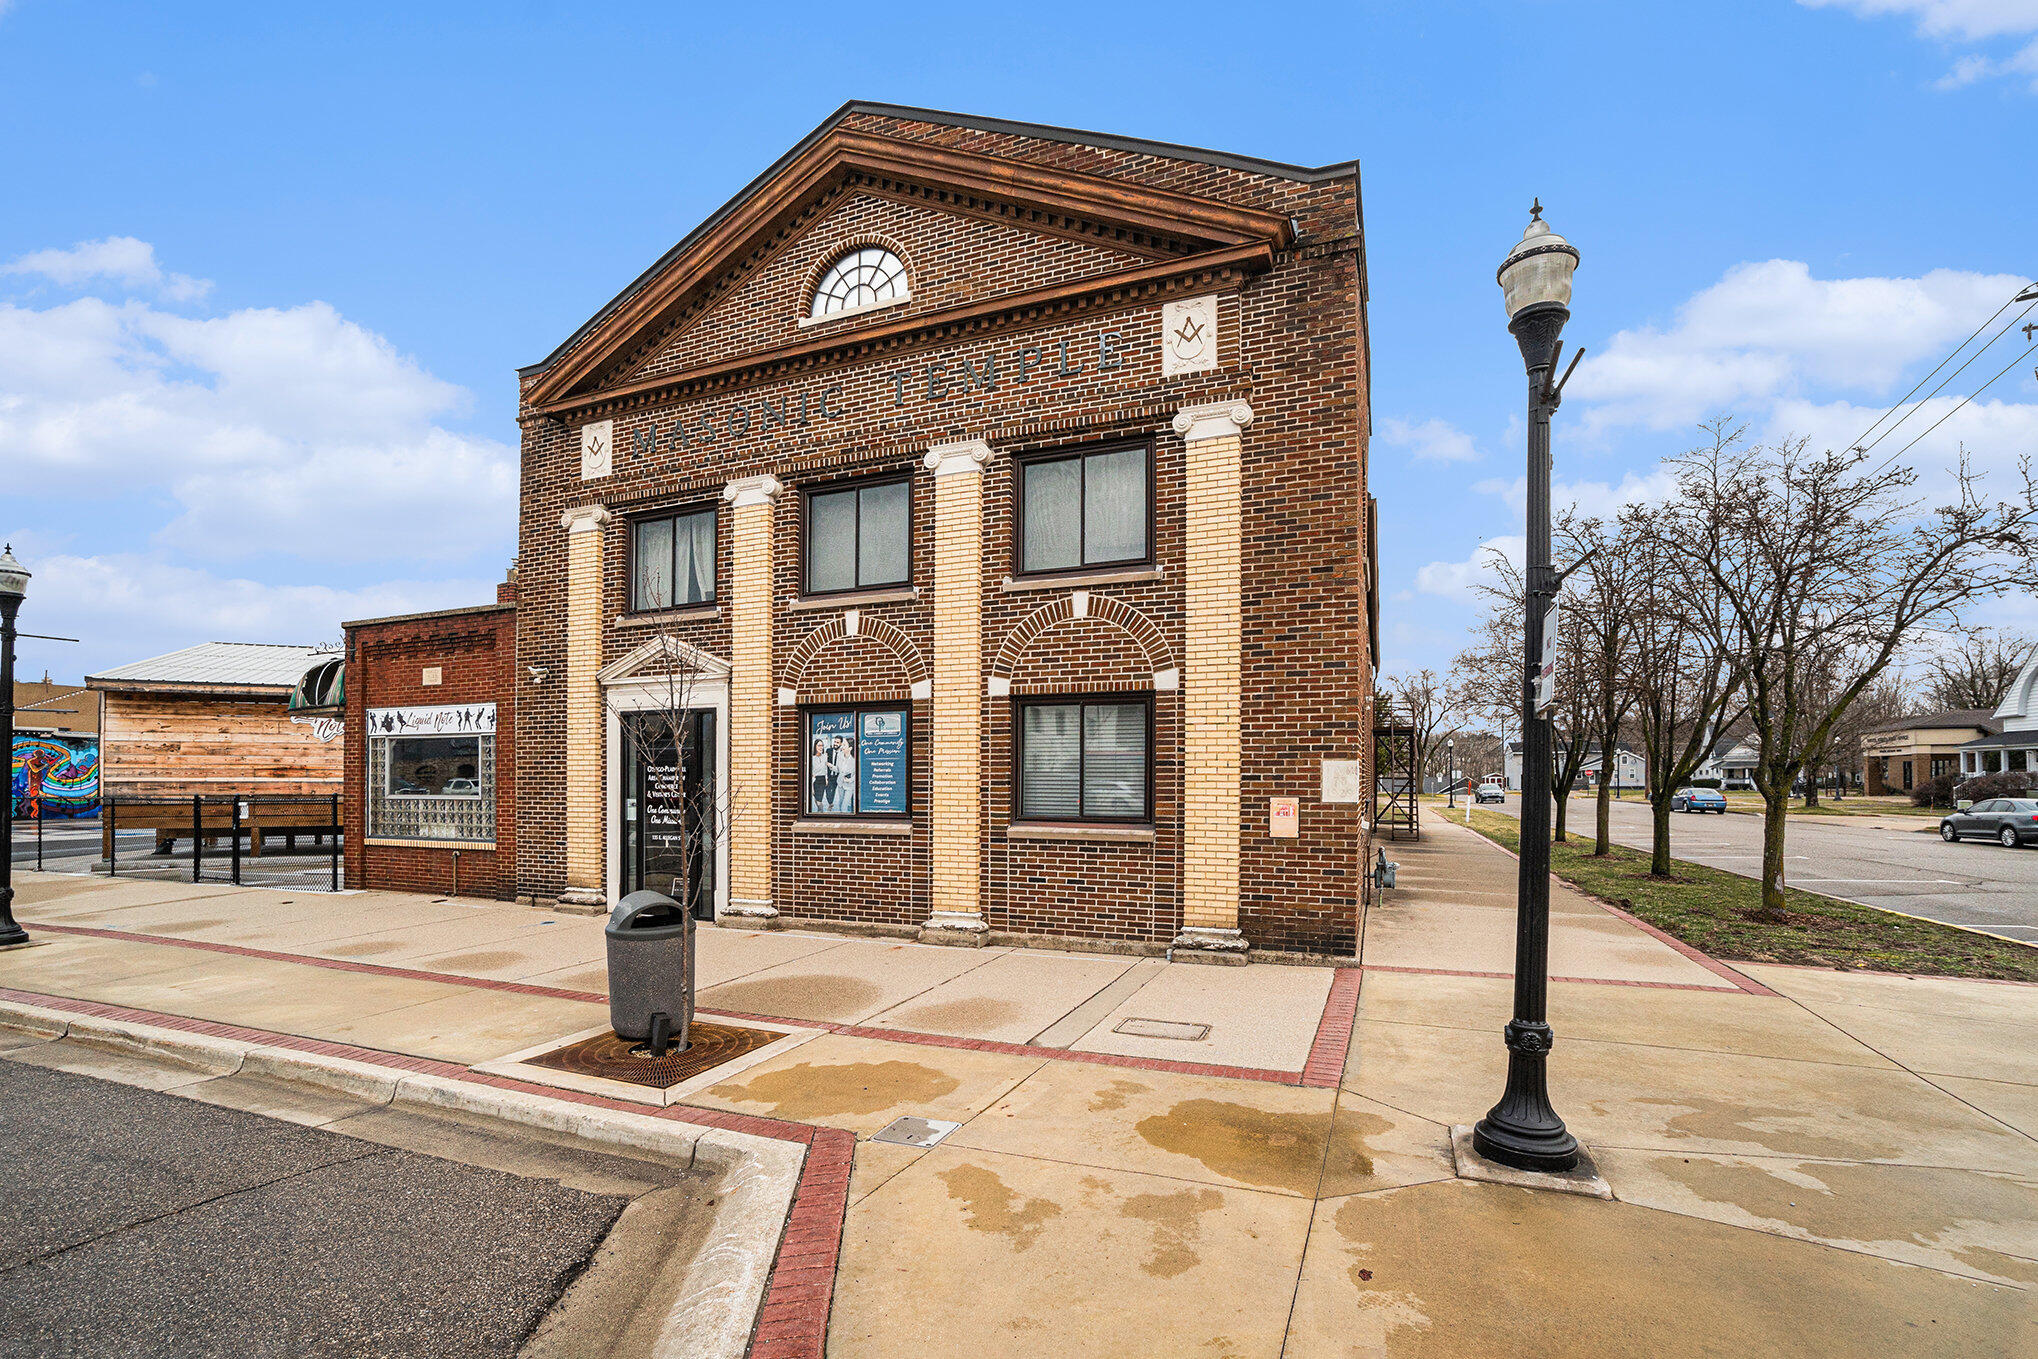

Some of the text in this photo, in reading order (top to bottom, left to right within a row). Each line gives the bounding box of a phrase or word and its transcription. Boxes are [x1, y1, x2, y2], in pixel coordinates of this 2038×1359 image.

[632, 331, 1124, 460] MASONIC TEMPLE
[316, 718, 345, 738] Not
[405, 711, 455, 732] Liquid Note
[816, 714, 853, 735] Join Us!
[860, 739, 873, 747] One
[863, 747, 876, 755] One
[647, 805, 686, 814] One Communy
[650, 814, 683, 825] One Missin
